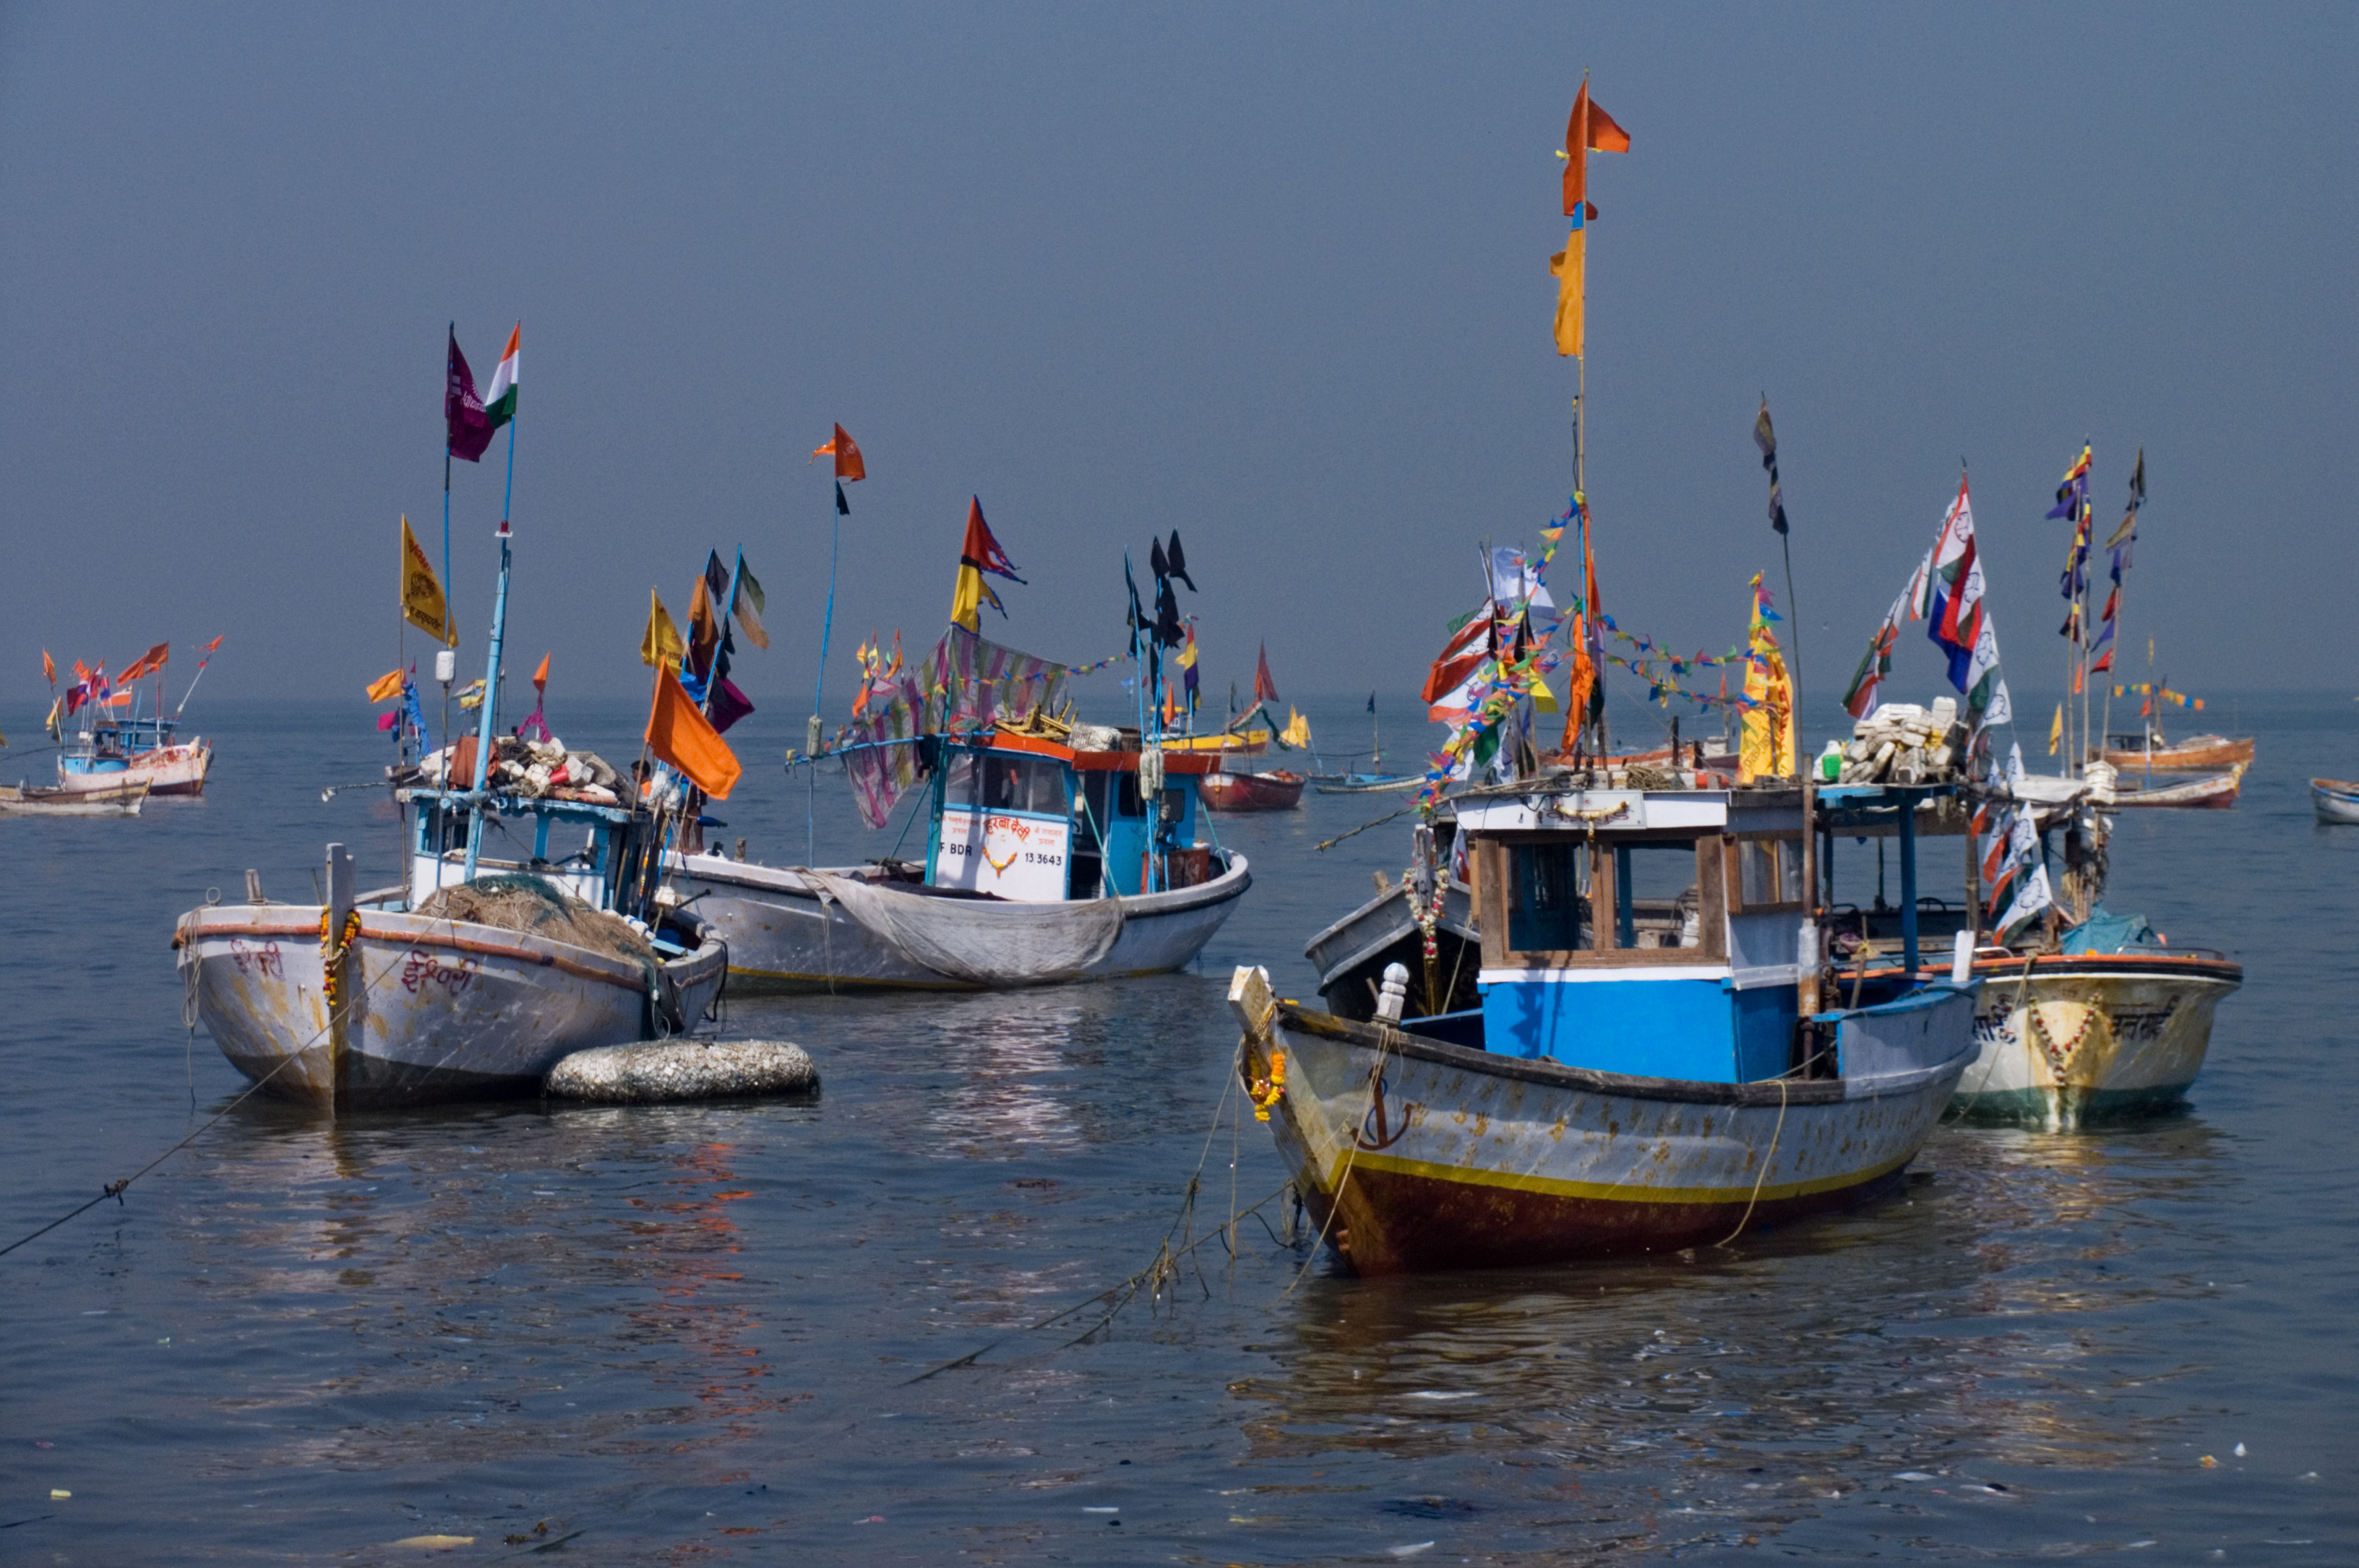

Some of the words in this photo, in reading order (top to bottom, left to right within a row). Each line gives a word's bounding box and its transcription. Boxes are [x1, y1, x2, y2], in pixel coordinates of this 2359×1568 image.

[950, 843, 972, 856] BDR
[1025, 852, 1034, 862] 13
[1037, 853, 1062, 866] 3643
